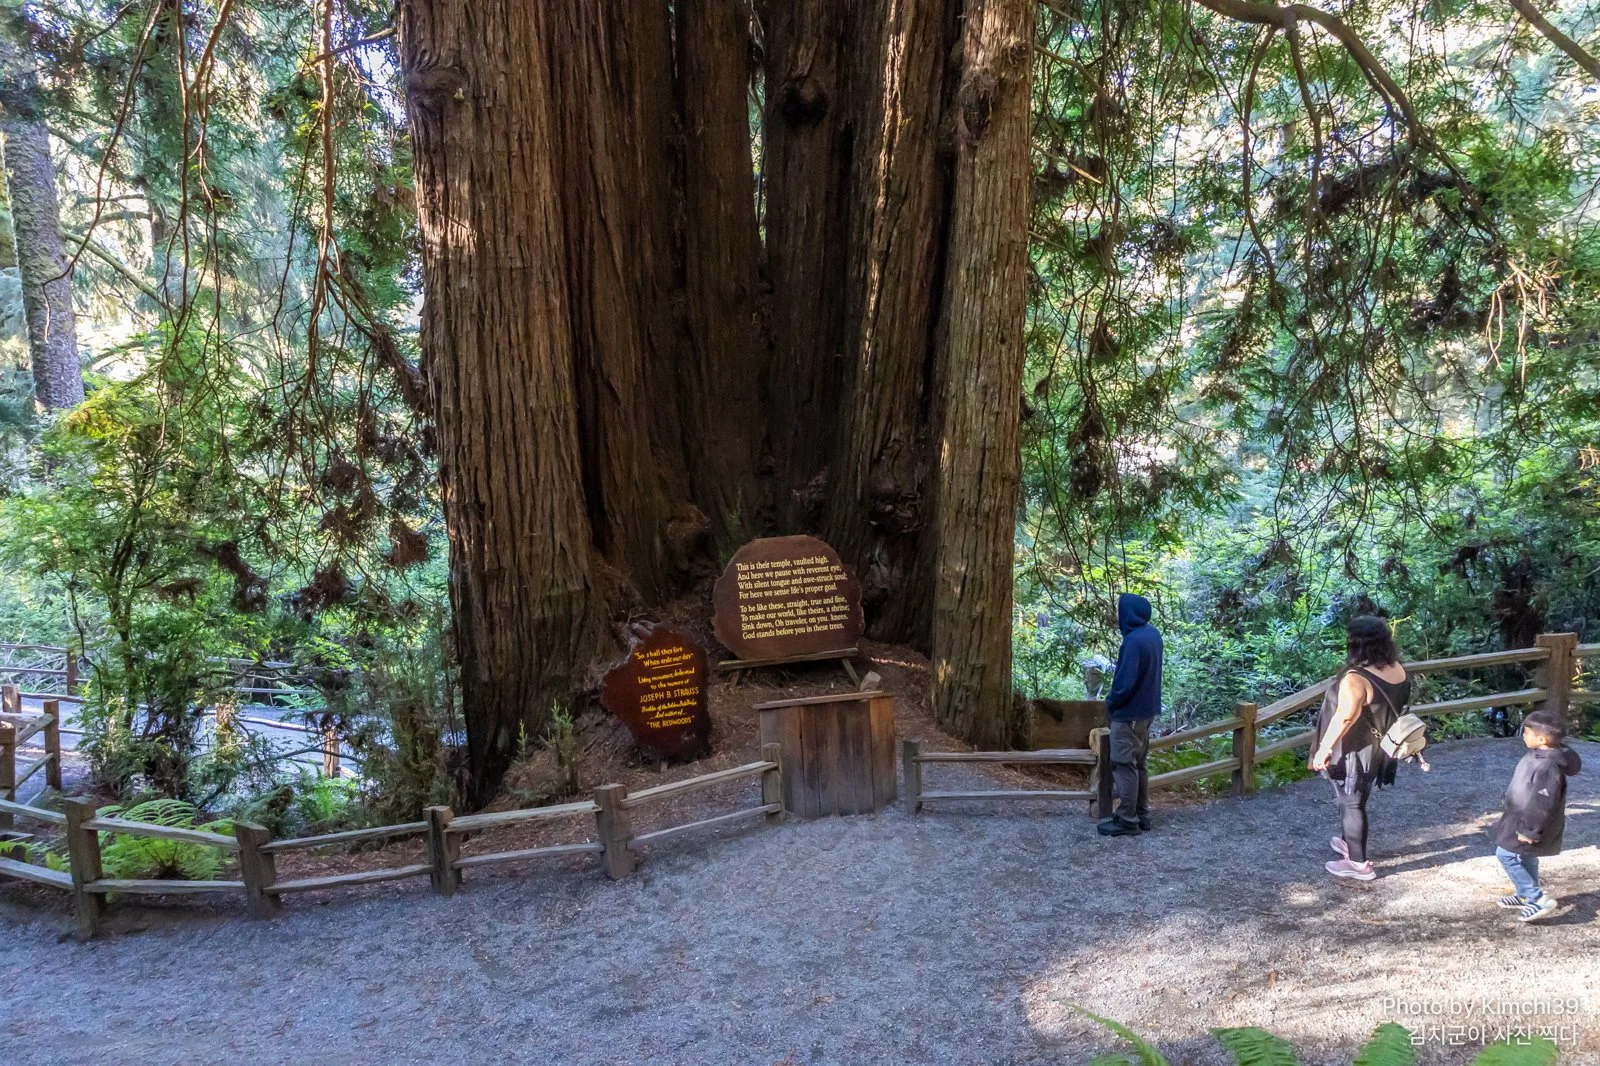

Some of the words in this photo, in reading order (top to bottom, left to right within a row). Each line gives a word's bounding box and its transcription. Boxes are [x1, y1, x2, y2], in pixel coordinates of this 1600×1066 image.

[771, 559, 792, 568] temple,
[793, 557, 814, 566] vaulted
[775, 569, 791, 578] pause
[771, 579, 790, 587] tongue
[803, 574, 833, 583] awe-struck
[805, 584, 823, 594] proper
[787, 600, 809, 609] straight,
[777, 610, 795, 618] world,
[808, 606, 825, 614] theirs,
[776, 627, 794, 635] before
[795, 627, 805, 635] you
[640, 692, 664, 703] JOSEPH
[674, 687, 699, 697] STRAUSS
